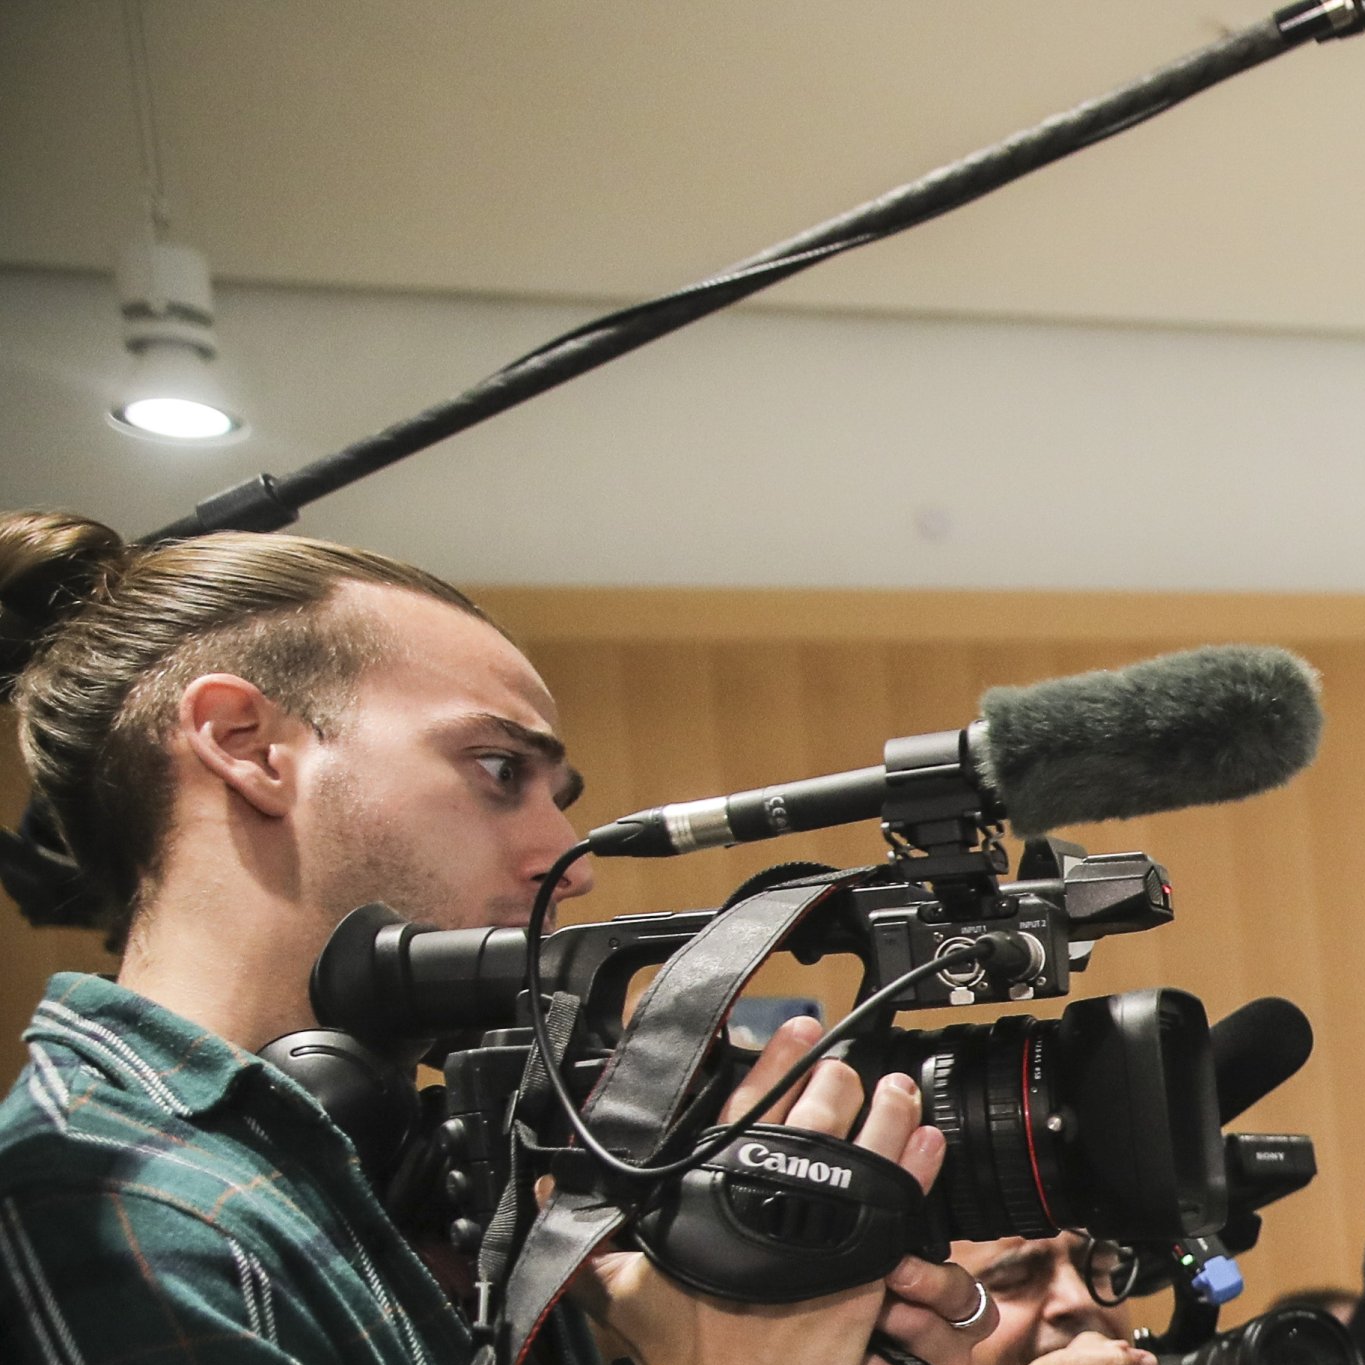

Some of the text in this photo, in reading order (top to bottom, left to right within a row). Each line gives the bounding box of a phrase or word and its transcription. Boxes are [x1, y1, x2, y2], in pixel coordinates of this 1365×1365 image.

[1019, 920, 1040, 929] INPUT
[961, 925, 982, 934] INPUT
[738, 1142, 852, 1189] Canon
